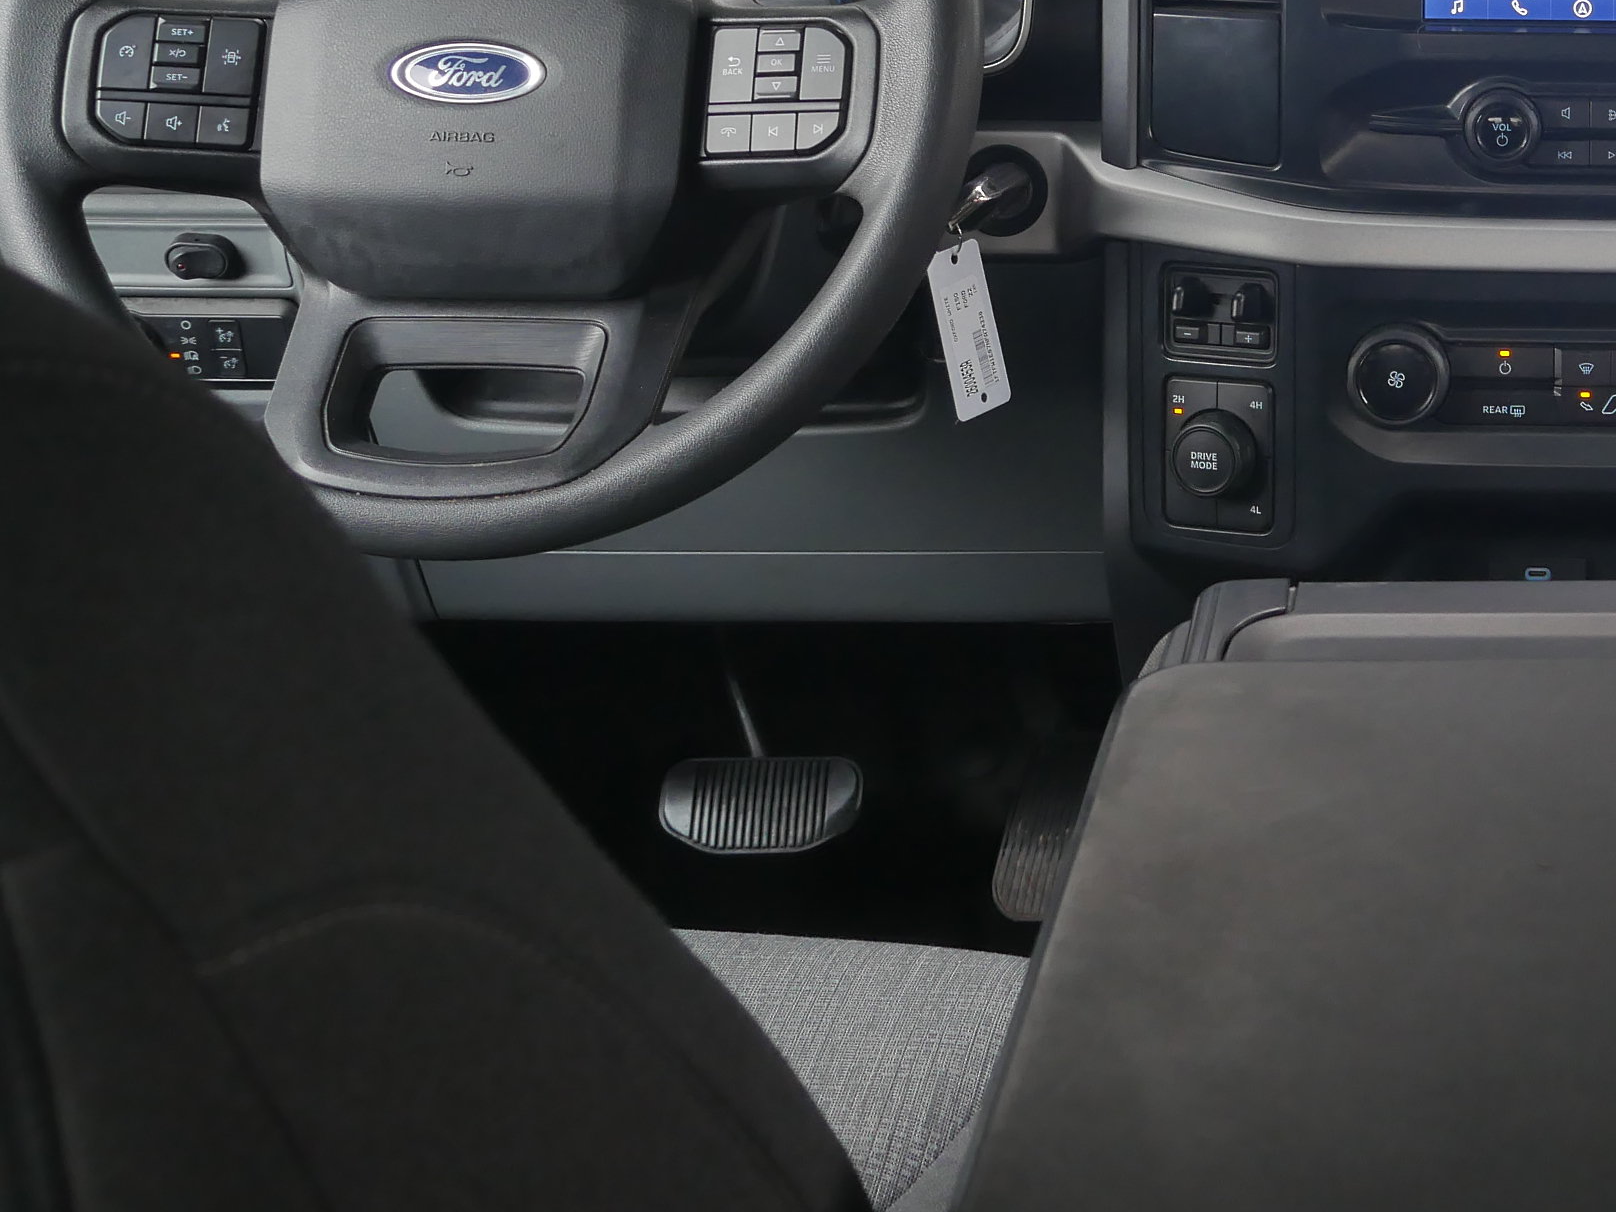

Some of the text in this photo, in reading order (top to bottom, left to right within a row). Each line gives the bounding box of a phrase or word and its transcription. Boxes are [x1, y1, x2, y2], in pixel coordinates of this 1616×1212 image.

[427, 55, 506, 88] Ford
[722, 68, 743, 76] BACK
[1491, 123, 1512, 132] VOL
[429, 130, 496, 143] AIRBAG
[1172, 395, 1185, 404] 2H
[1250, 401, 1263, 410] 4H
[1482, 405, 1508, 414] REAR
[1190, 451, 1218, 461] DRIVE
[1190, 460, 1218, 470] MODE
[1250, 505, 1262, 514] 4L
